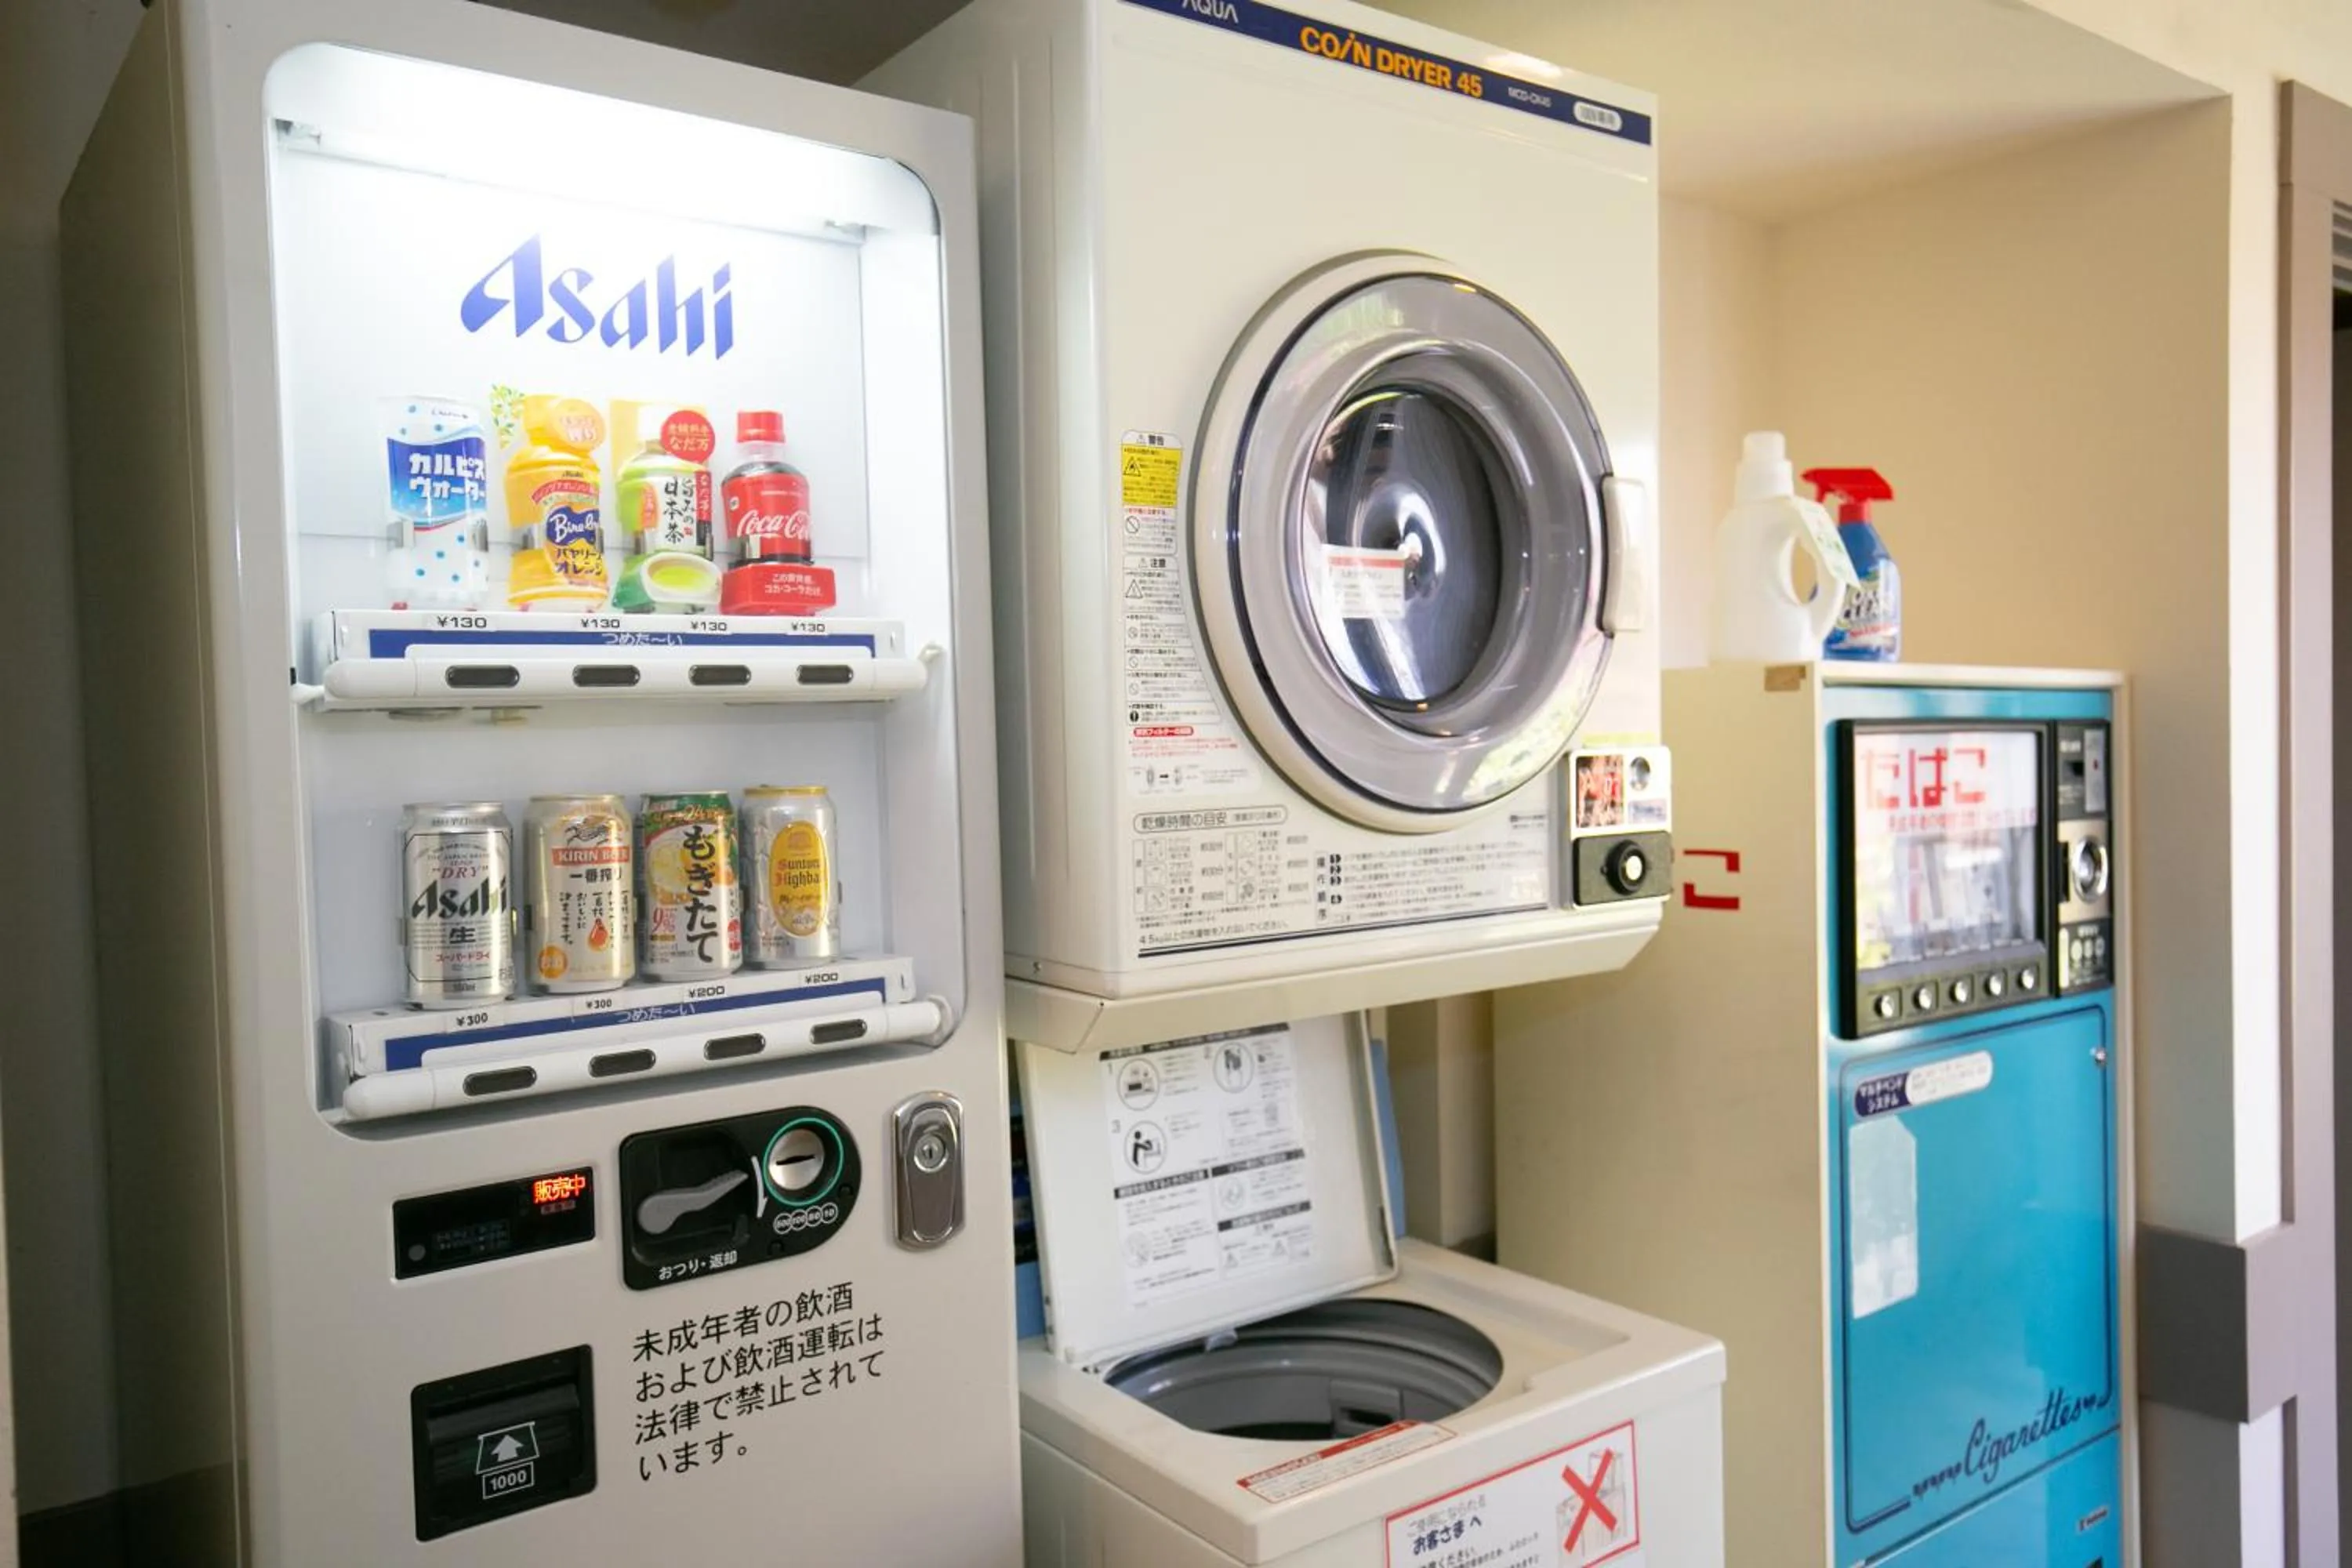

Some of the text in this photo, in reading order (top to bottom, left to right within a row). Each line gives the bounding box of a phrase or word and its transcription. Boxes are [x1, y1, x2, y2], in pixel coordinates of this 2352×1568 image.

[1376, 48, 1452, 89] DRYER
[1456, 72, 1483, 99] 45
[459, 233, 734, 361] Asahi
[408, 452, 486, 481] カルピス
[662, 476, 684, 545] 日本茶
[437, 615, 488, 629] ¥130
[580, 618, 621, 629] ¥130
[691, 620, 728, 632] ¥130
[791, 622, 826, 633] ¥130
[558, 849, 599, 862] KIRIN
[412, 874, 507, 920] Asahi
[683, 825, 718, 963] もぎたて
[448, 926, 477, 944] 生
[688, 985, 725, 999] ¥200
[804, 971, 839, 985] ¥200
[586, 999, 612, 1009] ¥300
[456, 1012, 488, 1027] ¥300
[534, 1174, 586, 1204] 販売中
[659, 1250, 737, 1280] おつり・返却
[633, 1282, 853, 1363] 未成年者の飲酒
[636, 1313, 884, 1403] および飲酒運転は
[635, 1350, 884, 1445] 法律で禁止されて
[1963, 1388, 2082, 1484] Cigarettes
[639, 1431, 747, 1482] います。
[489, 1470, 527, 1491] 1000
